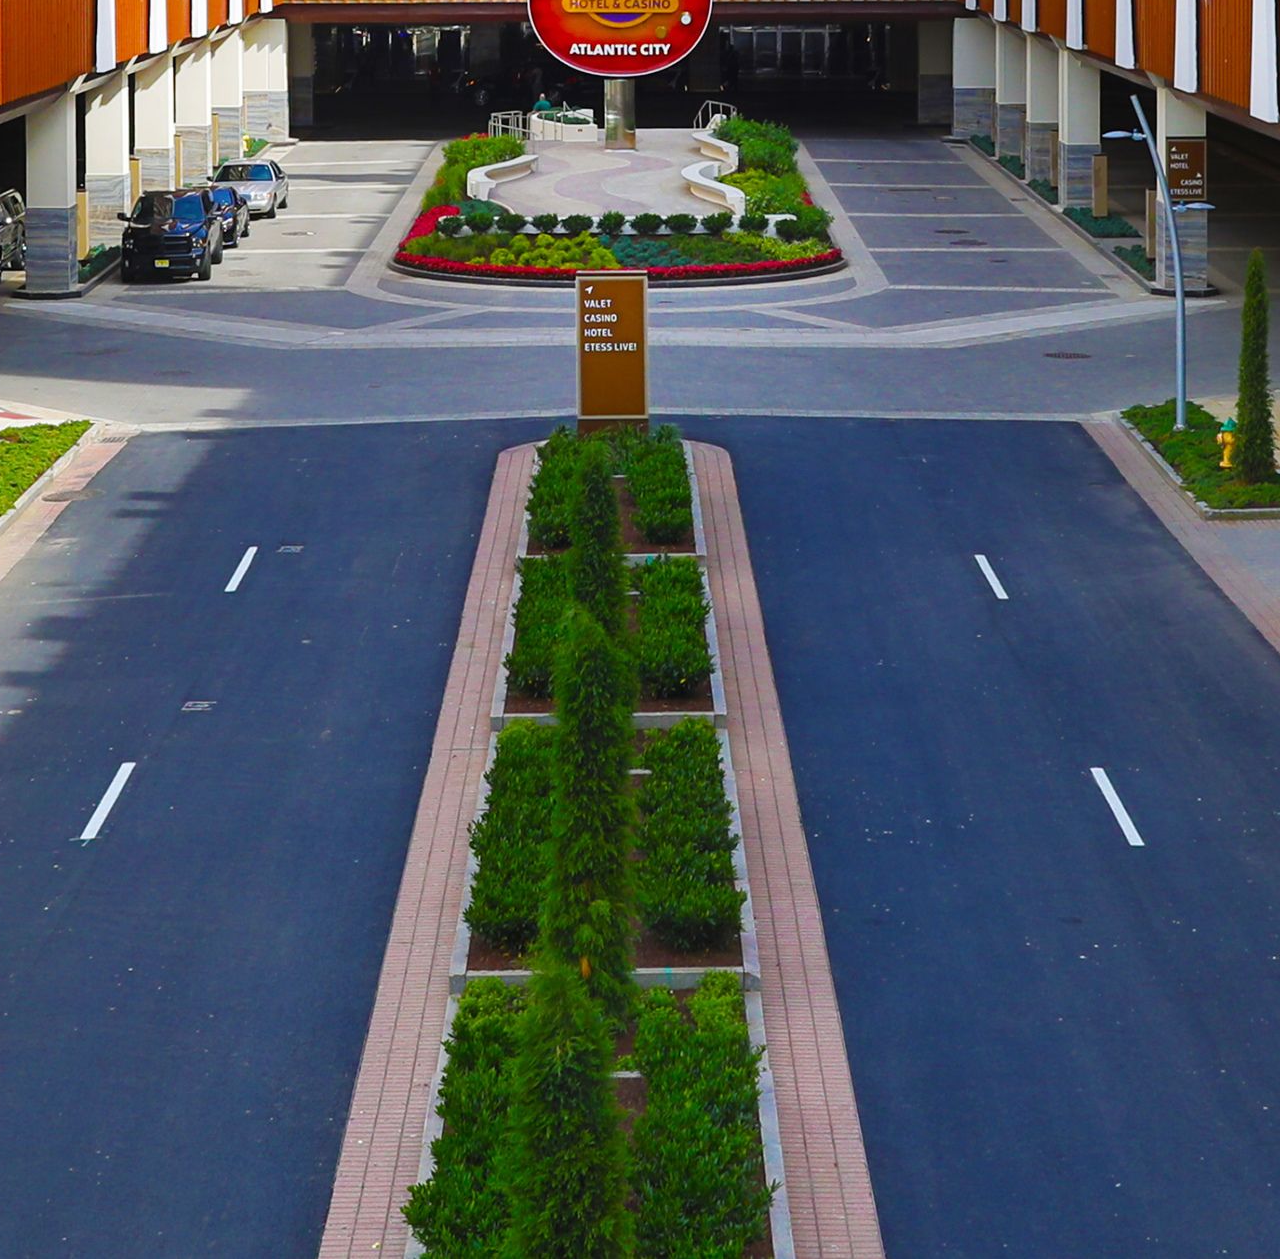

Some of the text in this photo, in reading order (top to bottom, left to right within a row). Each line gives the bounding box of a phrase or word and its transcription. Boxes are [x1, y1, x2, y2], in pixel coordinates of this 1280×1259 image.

[570, 0, 671, 9] HOTEL & CASINO
[569, 43, 671, 56] ATLANTIC CITY
[584, 299, 611, 308] VALET
[584, 314, 617, 323] CASINO
[584, 328, 612, 337] HOTEL
[584, 343, 637, 352] ETESS LIVE!
